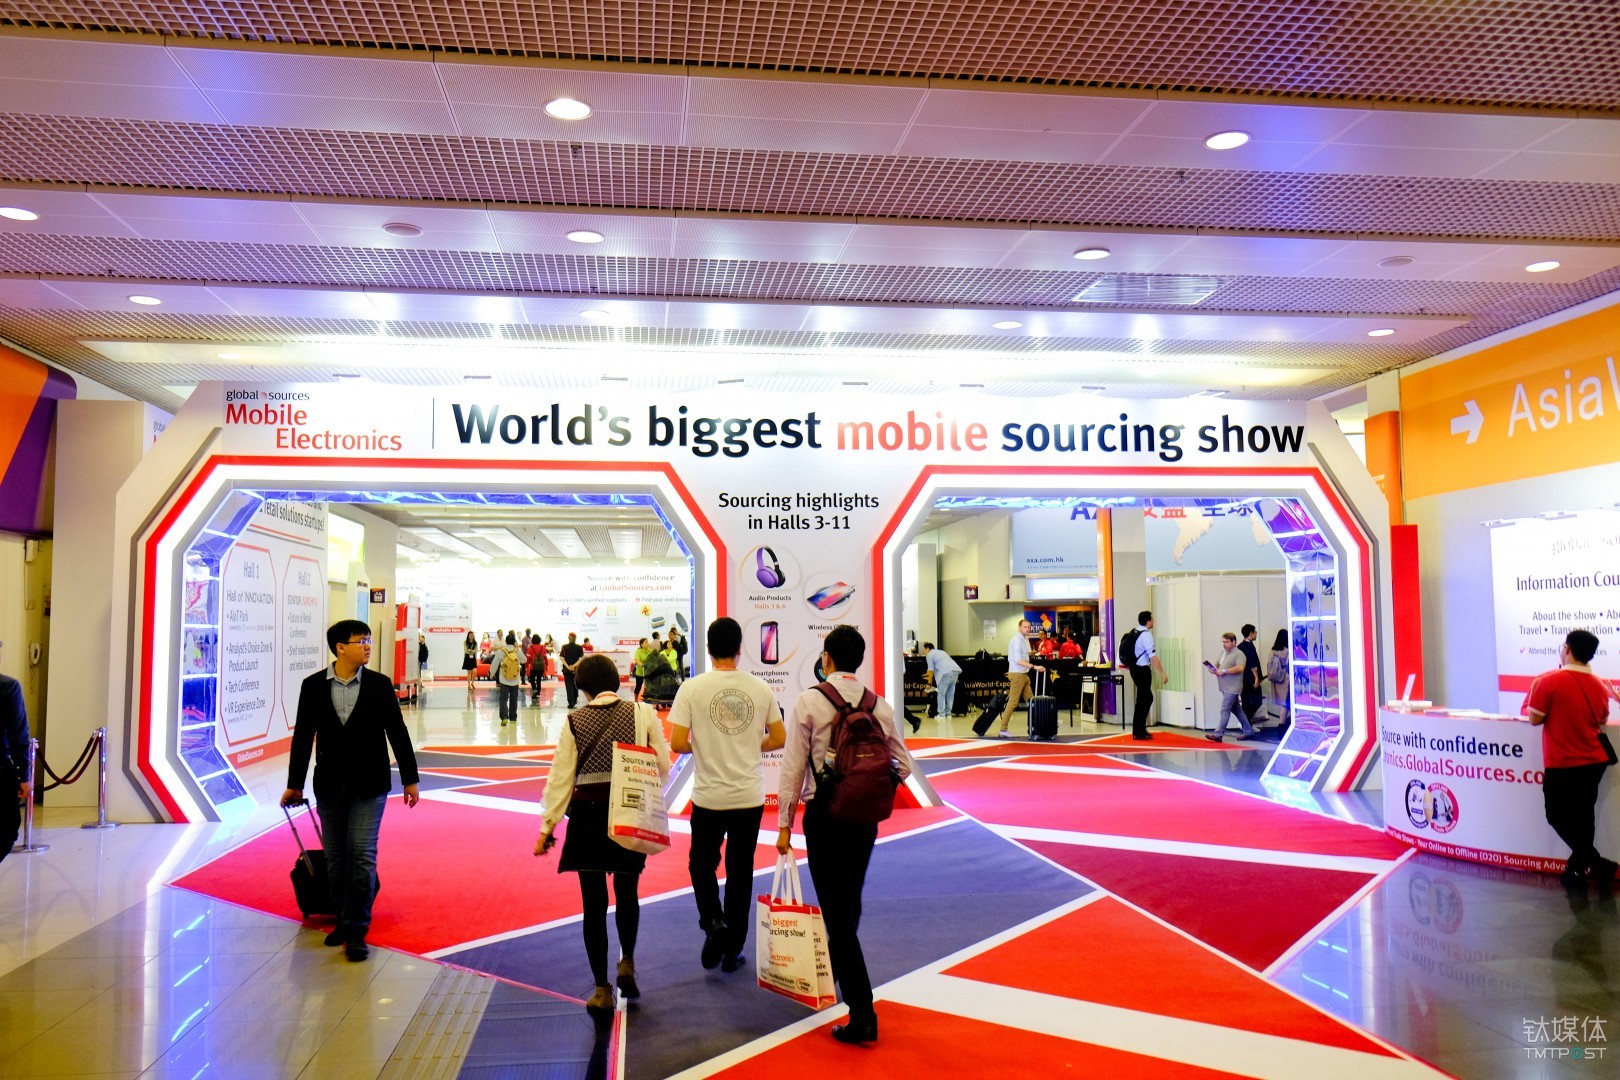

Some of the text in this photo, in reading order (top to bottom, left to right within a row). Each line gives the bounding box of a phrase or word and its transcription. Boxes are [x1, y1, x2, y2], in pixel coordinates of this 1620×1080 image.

[226, 390, 310, 401] global sources
[1508, 357, 1620, 438] Asia
[225, 403, 307, 426] Mobile
[276, 428, 402, 451] Electronics
[452, 403, 1305, 463] World's biggest mobile sourcing show
[718, 493, 879, 511] Sourcing highlights
[748, 514, 850, 530] in Halls 3-11
[1026, 556, 1064, 564] axa.com.hk
[243, 560, 256, 579] Hall
[1517, 572, 1590, 591] Information
[1533, 610, 1556, 621] About
[1558, 610, 1571, 620] the
[1574, 610, 1596, 620] show
[1519, 625, 1542, 635] Travel
[1529, 647, 1546, 655] Attend
[1548, 647, 1557, 655] the
[1403, 731, 1426, 749] with
[1430, 735, 1523, 758] confidence
[621, 755, 645, 765] Source
[624, 765, 631, 773] at
[1417, 838, 1428, 848] Your
[1428, 841, 1447, 853] Online
[1447, 846, 1455, 854] to
[1455, 847, 1478, 859] Offline
[1504, 855, 1541, 869] Sourcing
[773, 918, 798, 928] biggest
[790, 928, 806, 938] show!
